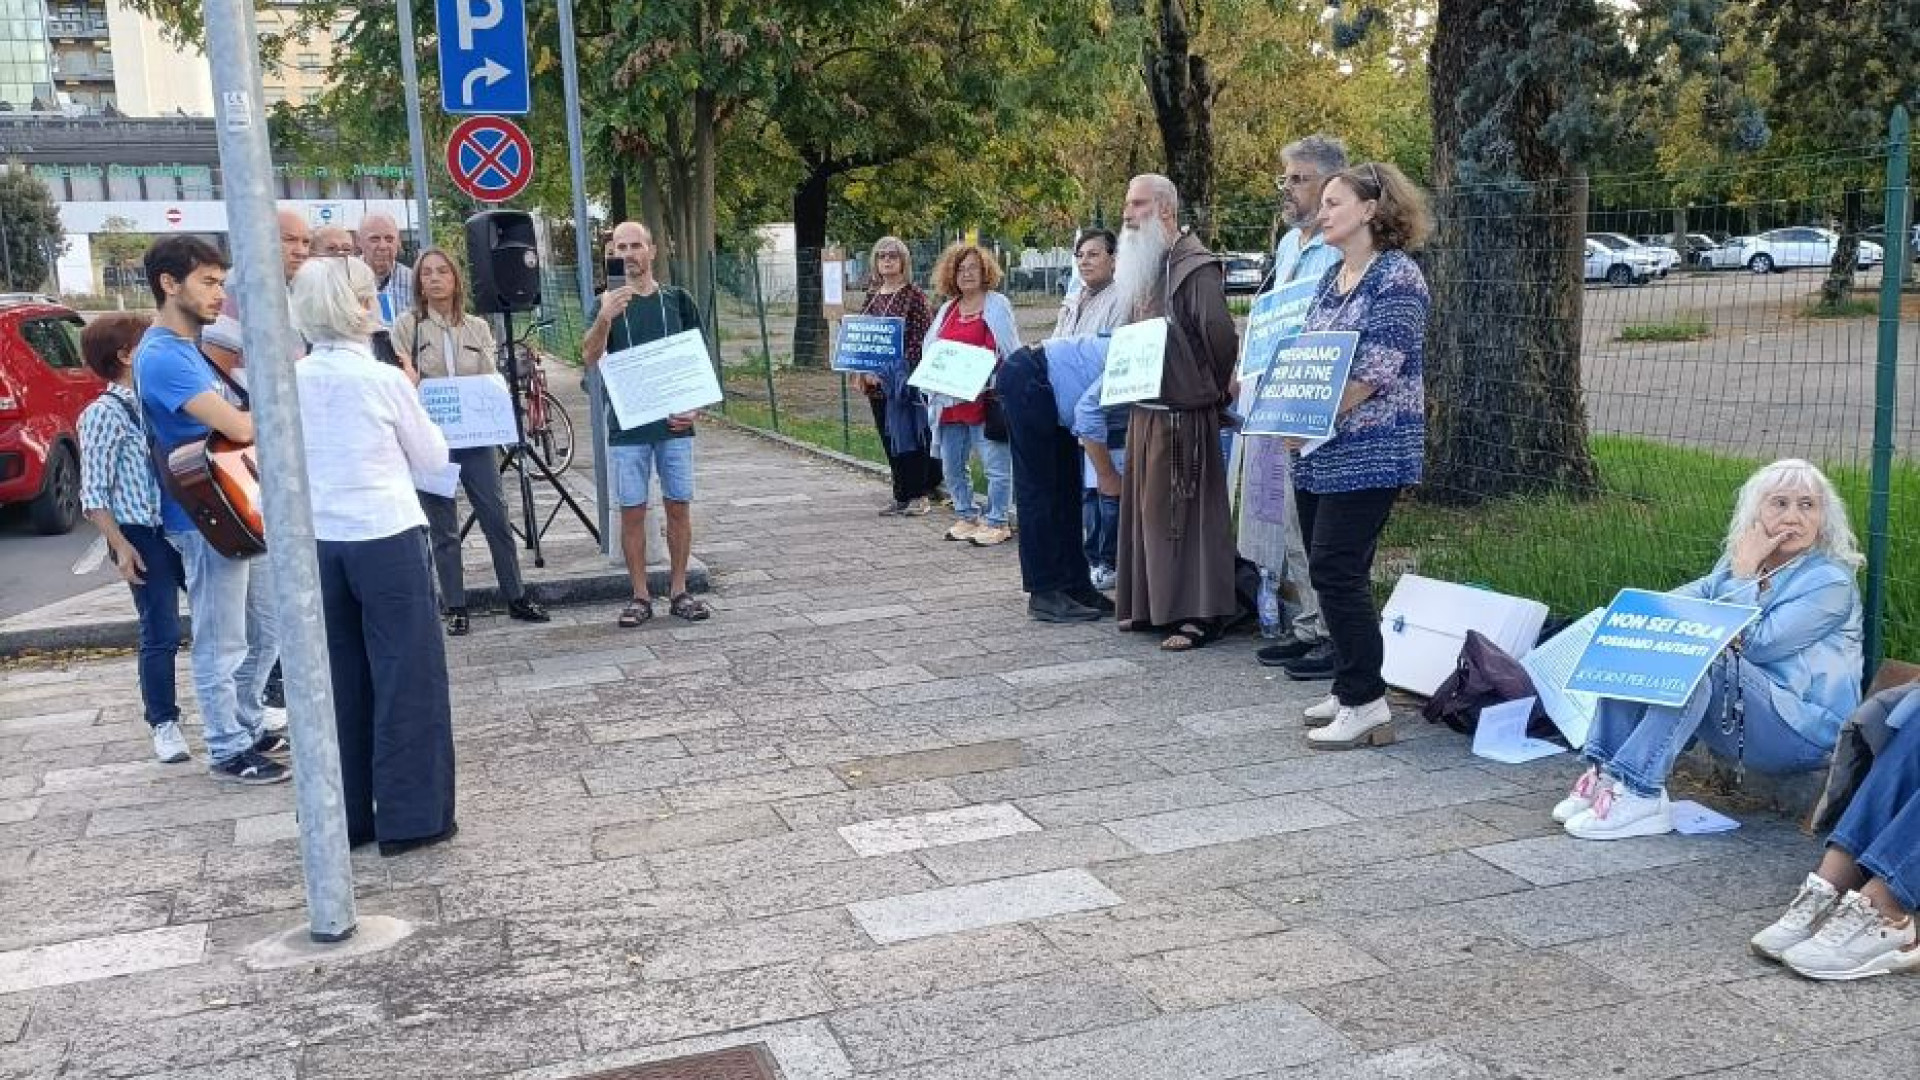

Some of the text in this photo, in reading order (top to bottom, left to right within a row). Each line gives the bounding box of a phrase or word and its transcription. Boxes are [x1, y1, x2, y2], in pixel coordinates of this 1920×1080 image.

[457, 0, 503, 50] P
[1277, 346, 1341, 363] PREGHIAMO
[1288, 366, 1303, 380] LA
[1304, 365, 1334, 381] FINE
[1607, 611, 1726, 641] NON SEI SOLA
[1595, 634, 1653, 649] POSSIAMO
[1661, 677, 1688, 692] VITA
